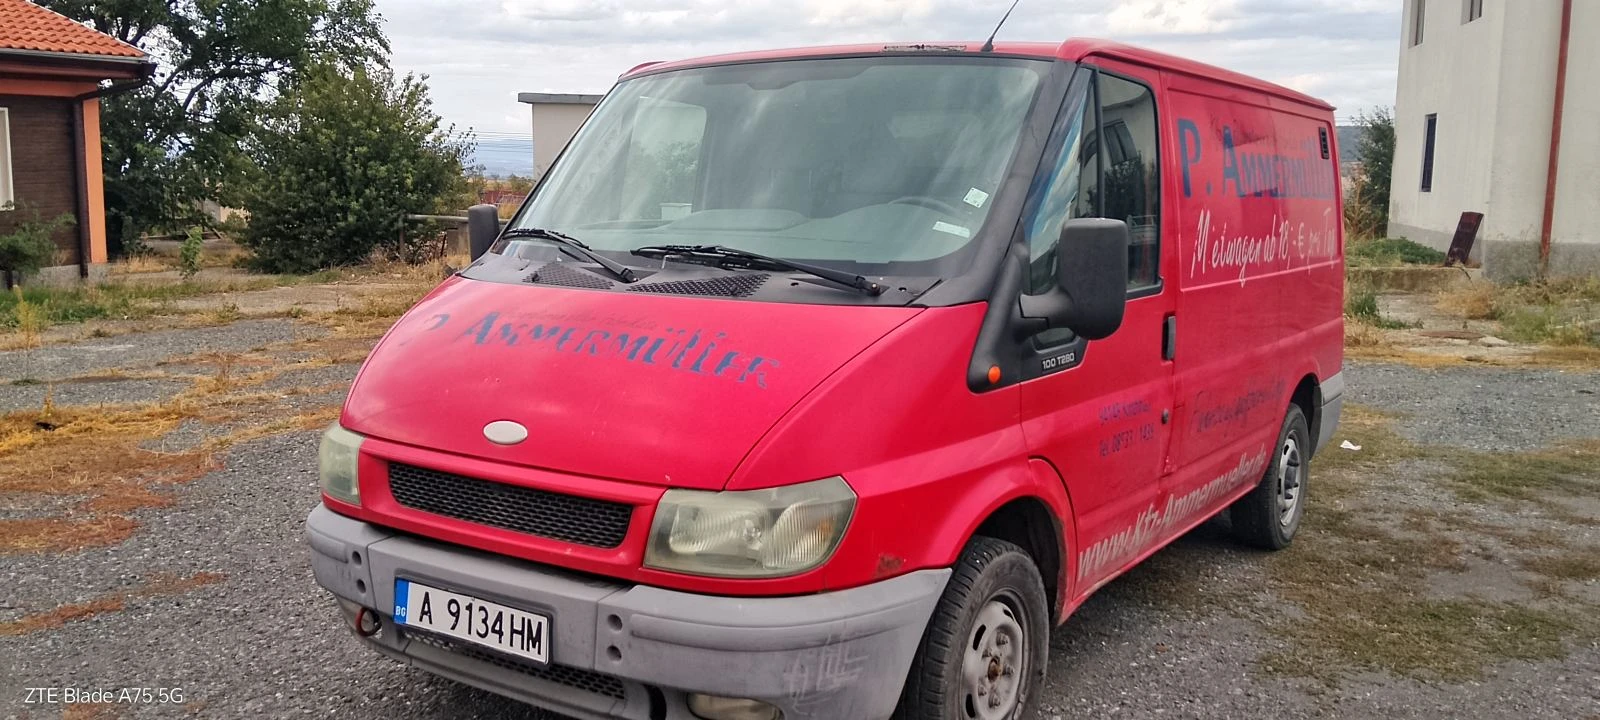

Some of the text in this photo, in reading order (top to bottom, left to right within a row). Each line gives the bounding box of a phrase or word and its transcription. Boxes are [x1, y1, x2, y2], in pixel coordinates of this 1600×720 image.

[1042, 352, 1075, 369] 100 T280
[395, 605, 406, 617] BG
[419, 591, 543, 656] A 9134 HM
